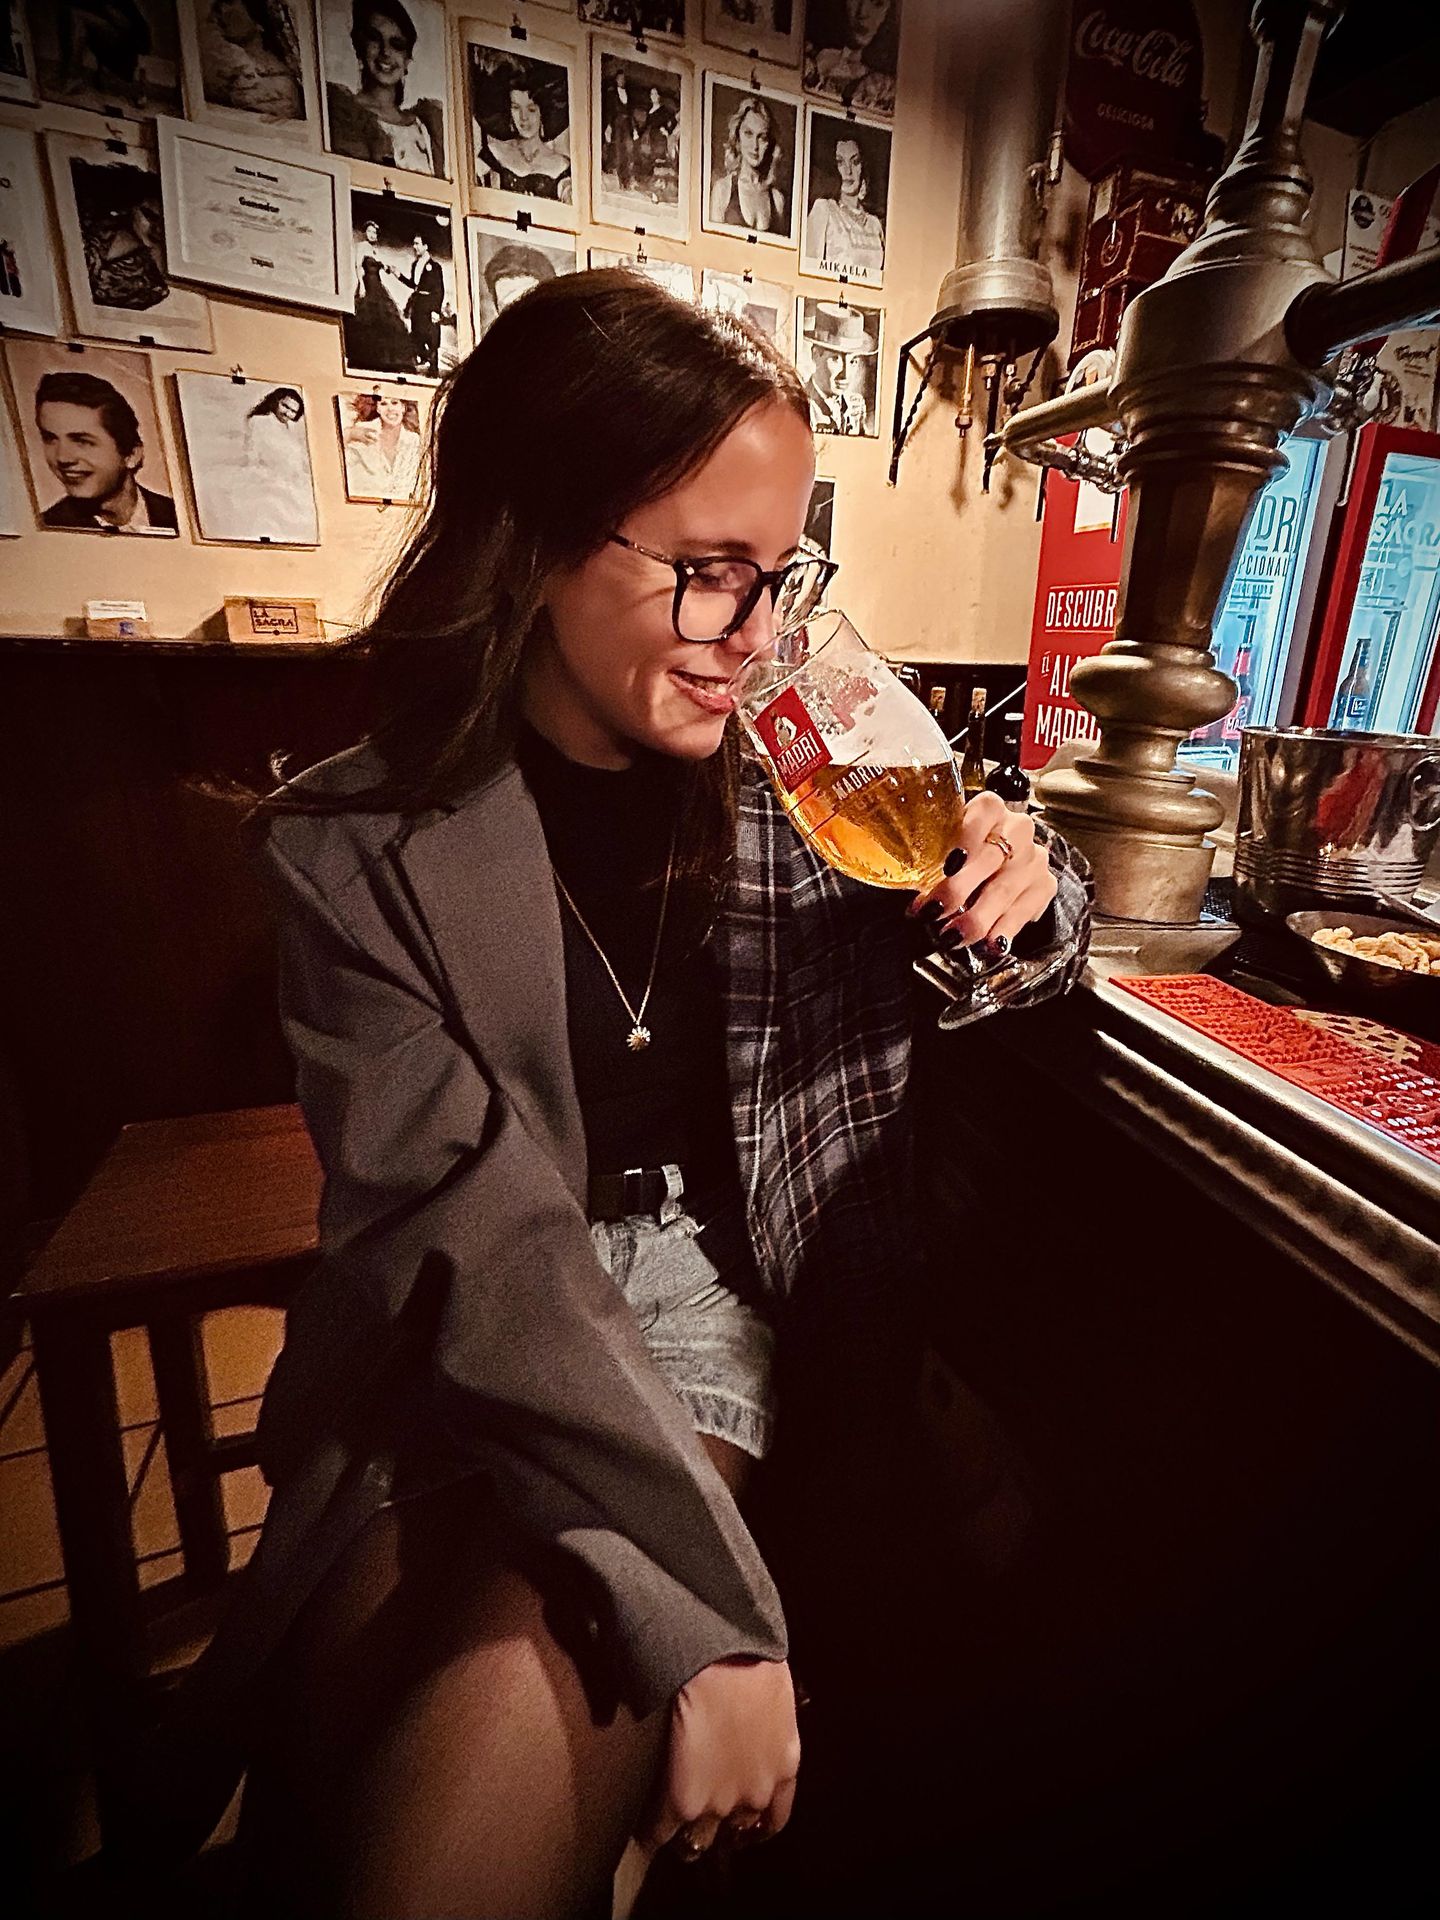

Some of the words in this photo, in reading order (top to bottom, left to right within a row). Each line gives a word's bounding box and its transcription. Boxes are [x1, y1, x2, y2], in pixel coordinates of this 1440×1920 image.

[1075, 10, 1194, 88] Coca-Cola
[819, 261, 867, 278] MIKAELA
[1379, 485, 1407, 516] LA
[253, 608, 270, 618] LA
[254, 618, 294, 627] SAGRA
[1045, 588, 1117, 628] DESCUBR
[1034, 704, 1102, 750] MADRI
